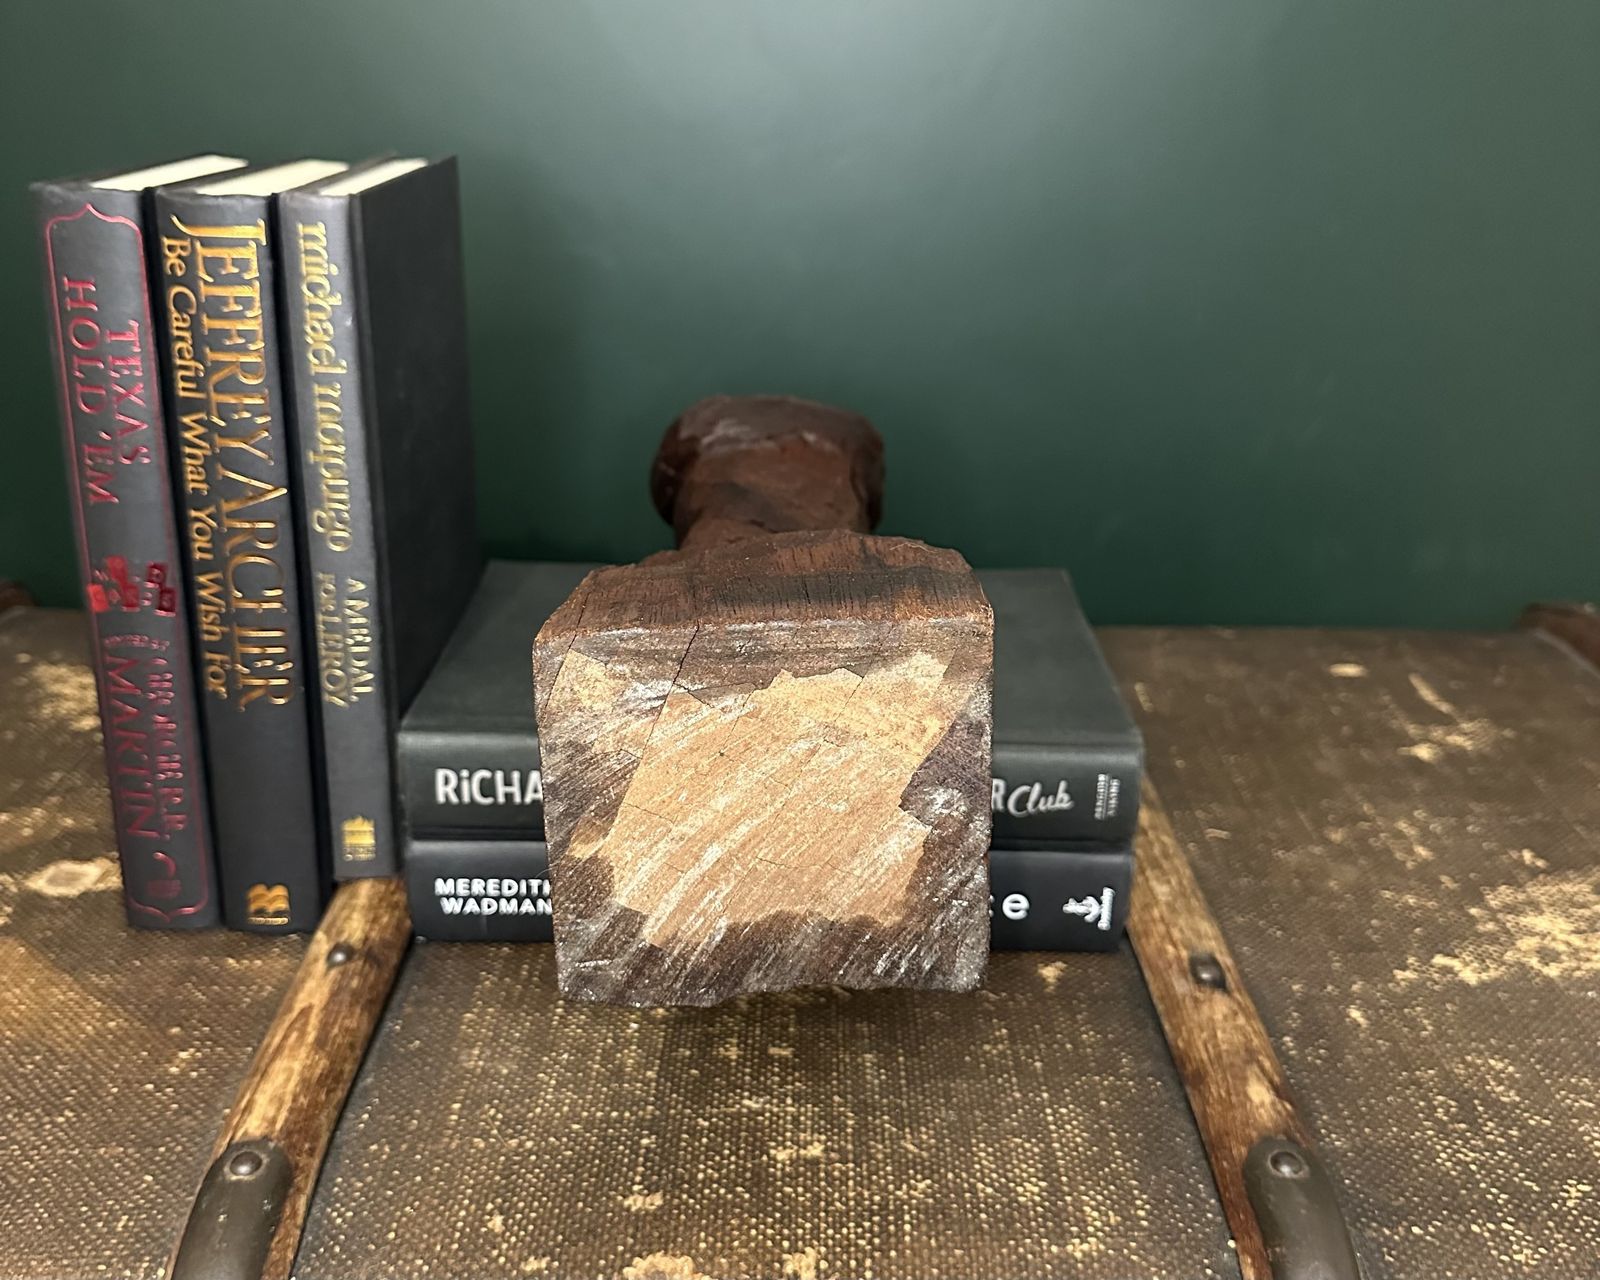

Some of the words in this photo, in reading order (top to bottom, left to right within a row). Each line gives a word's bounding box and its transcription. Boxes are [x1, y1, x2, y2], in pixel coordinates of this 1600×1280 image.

[161, 236, 192, 277] Be
[296, 220, 347, 375] michael
[62, 274, 107, 414] HOLD
[168, 285, 206, 399] Careful
[170, 214, 274, 465] JEFFREY
[106, 319, 151, 464] TEXAS
[82, 430, 119, 504] 'EM
[178, 411, 211, 496] What
[308, 382, 352, 552] morpurgo
[189, 505, 218, 560] You
[195, 572, 230, 642] Wish
[216, 463, 293, 712] ARCHER
[346, 577, 366, 593] A
[203, 651, 231, 698] For
[318, 614, 349, 708] LEROY
[344, 599, 375, 702] MEDAL
[104, 654, 169, 839] MARTIN
[1007, 780, 1074, 817] Club
[440, 897, 552, 915] WADMAN
